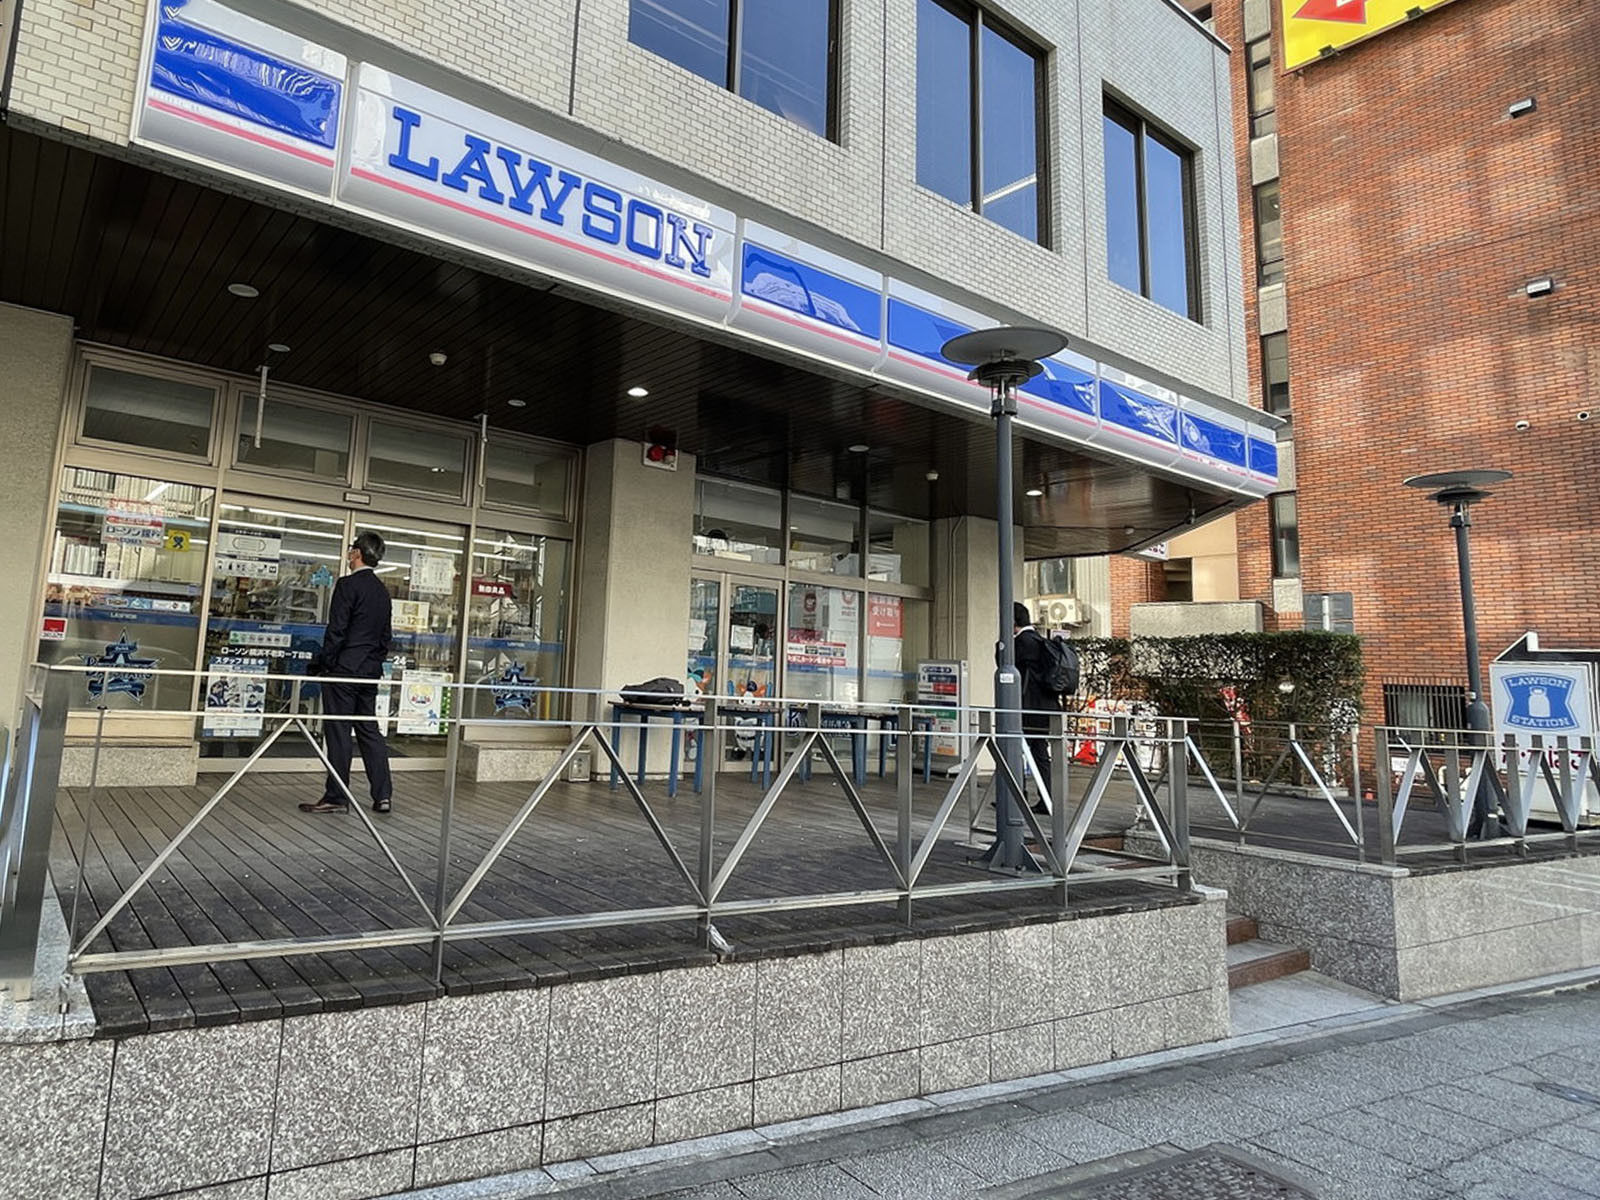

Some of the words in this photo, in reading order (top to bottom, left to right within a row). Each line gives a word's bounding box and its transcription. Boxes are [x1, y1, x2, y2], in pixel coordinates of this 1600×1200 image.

[388, 106, 713, 278] LAWSON
[1508, 677, 1569, 689] LAWSON
[1511, 715, 1571, 727] STATION
